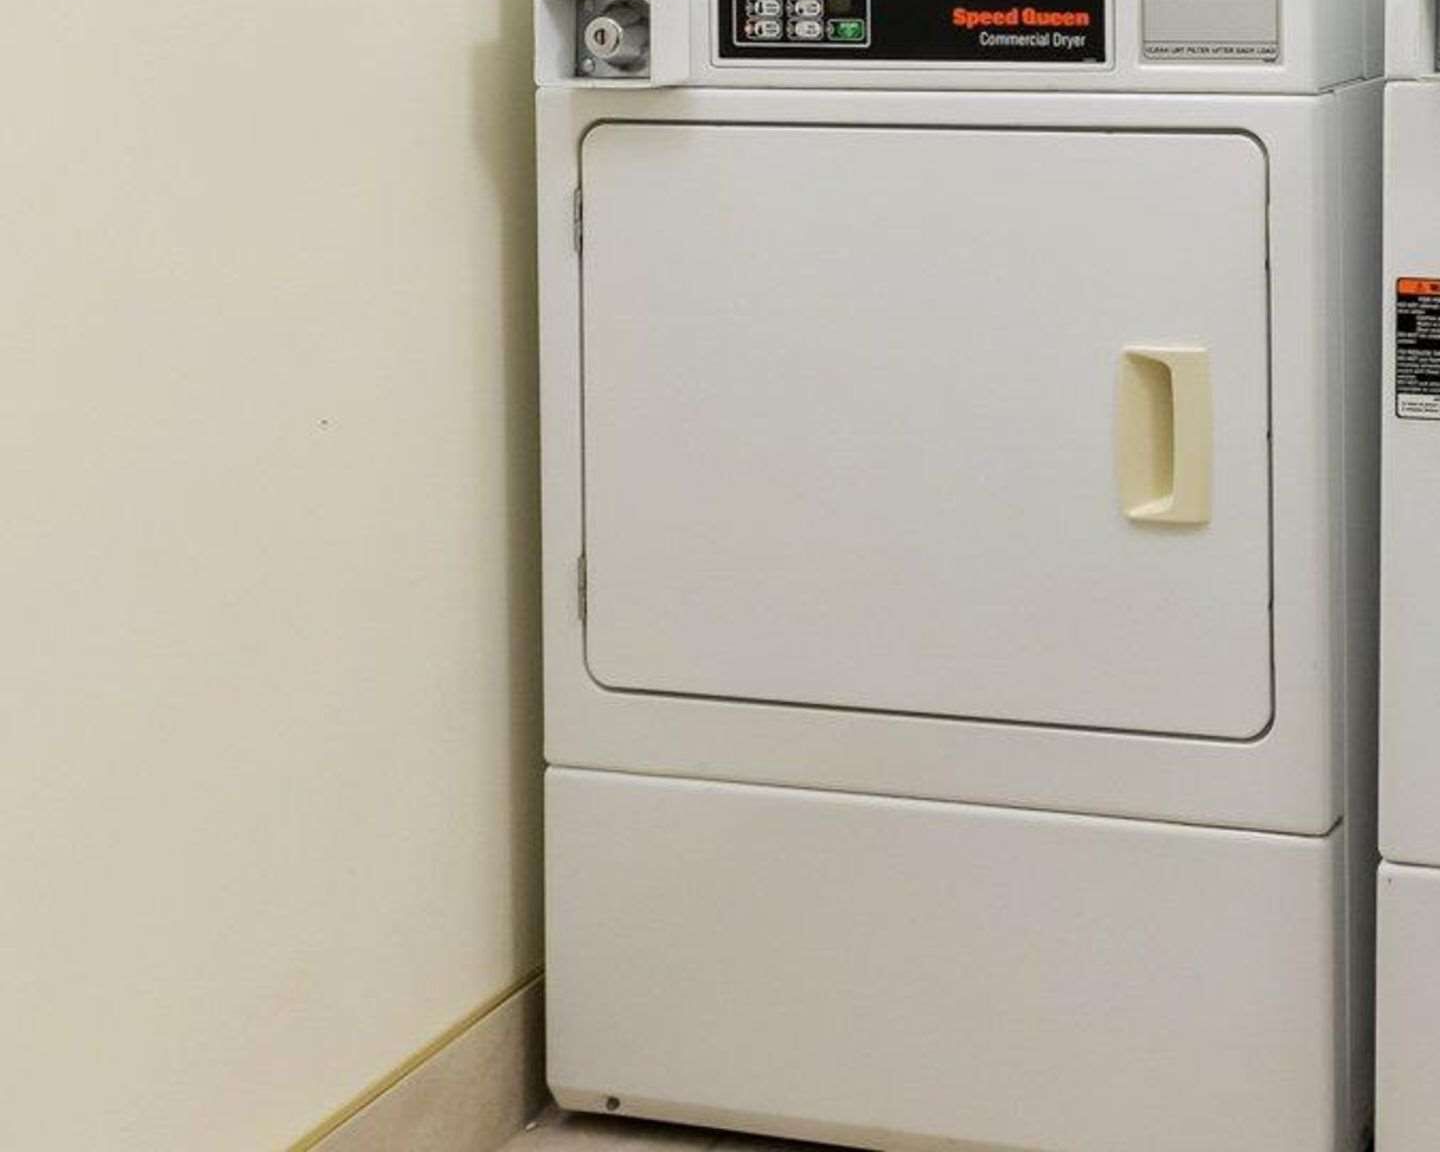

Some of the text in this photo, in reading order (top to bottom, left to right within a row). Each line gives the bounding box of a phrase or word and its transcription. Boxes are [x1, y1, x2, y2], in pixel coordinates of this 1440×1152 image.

[952, 7, 1090, 29] Speed Queen
[979, 31, 1086, 50] Commercial Dryer
